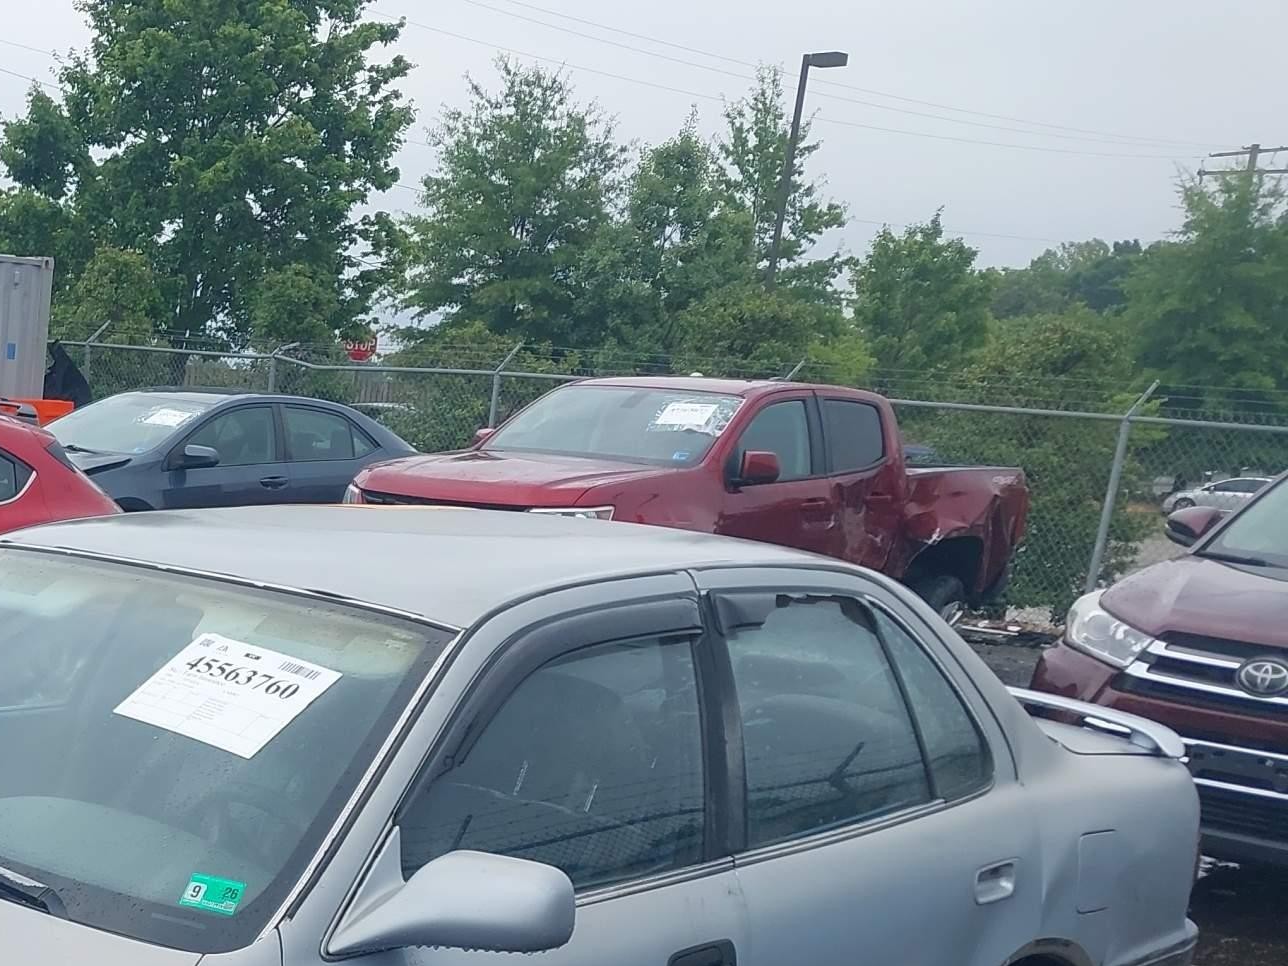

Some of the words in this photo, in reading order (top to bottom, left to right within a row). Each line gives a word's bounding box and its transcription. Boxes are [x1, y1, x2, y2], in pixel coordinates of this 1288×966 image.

[346, 338, 376, 351] STOP
[186, 655, 300, 700] 45563760
[190, 885, 202, 898] 9
